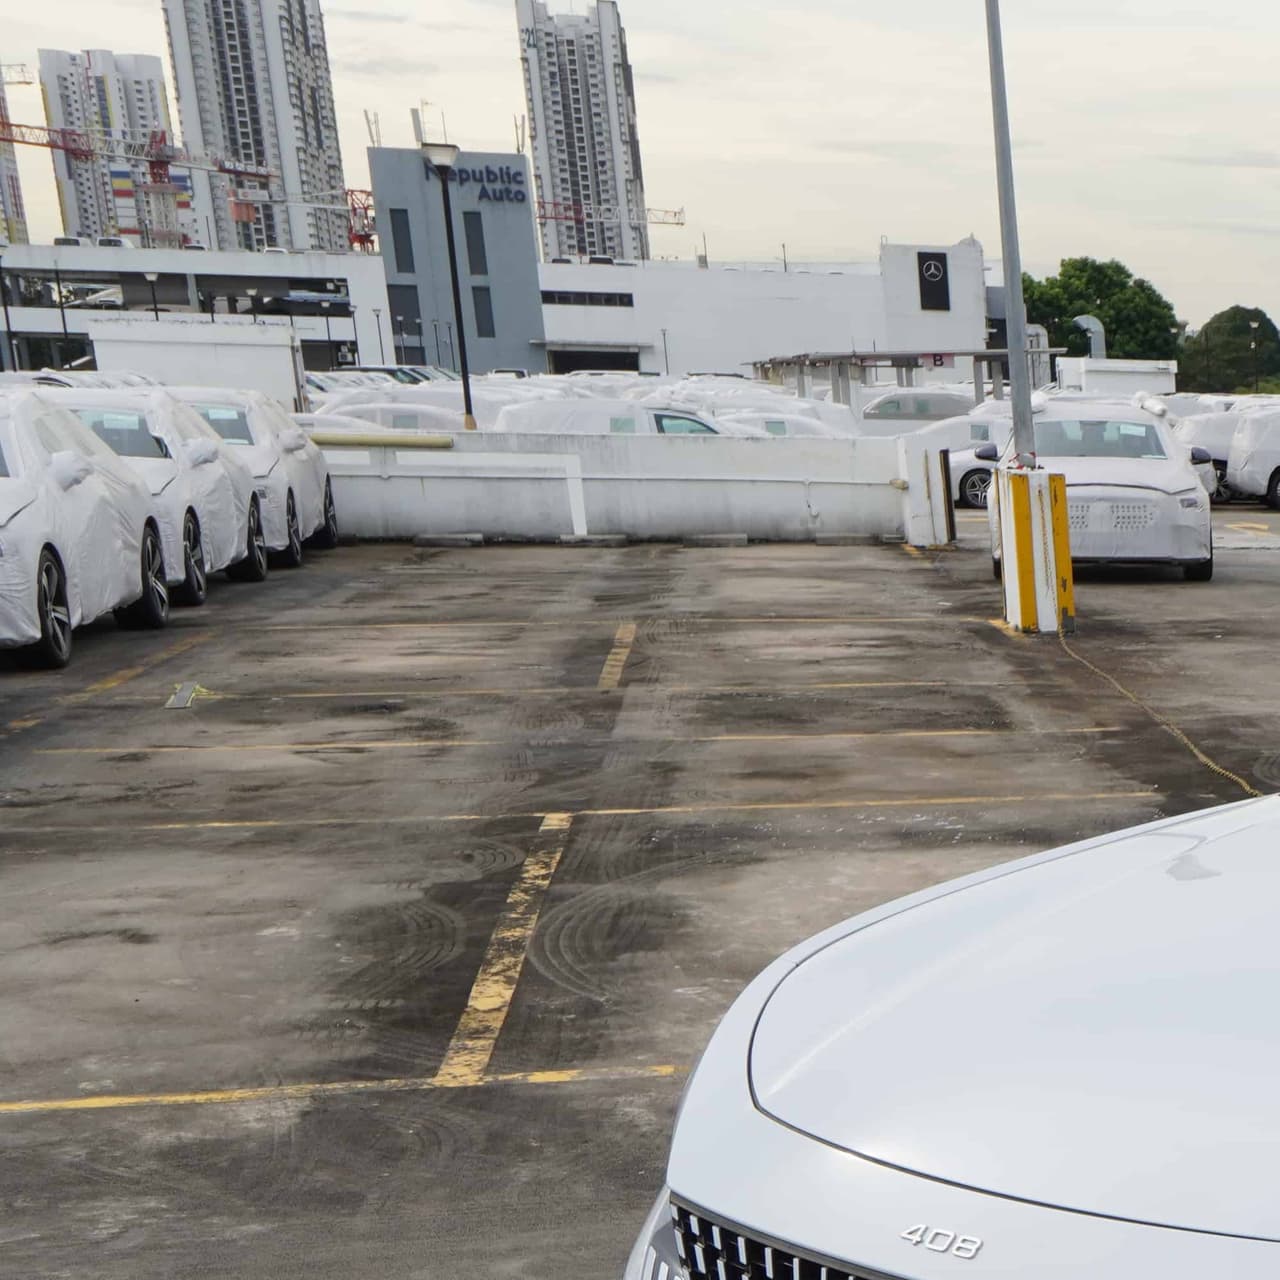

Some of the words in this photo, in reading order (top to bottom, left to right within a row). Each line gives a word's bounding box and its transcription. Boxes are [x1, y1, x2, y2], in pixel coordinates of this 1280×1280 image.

[478, 183, 526, 203] Auto
[932, 353, 945, 368] B
[900, 1223, 984, 1260] 408
